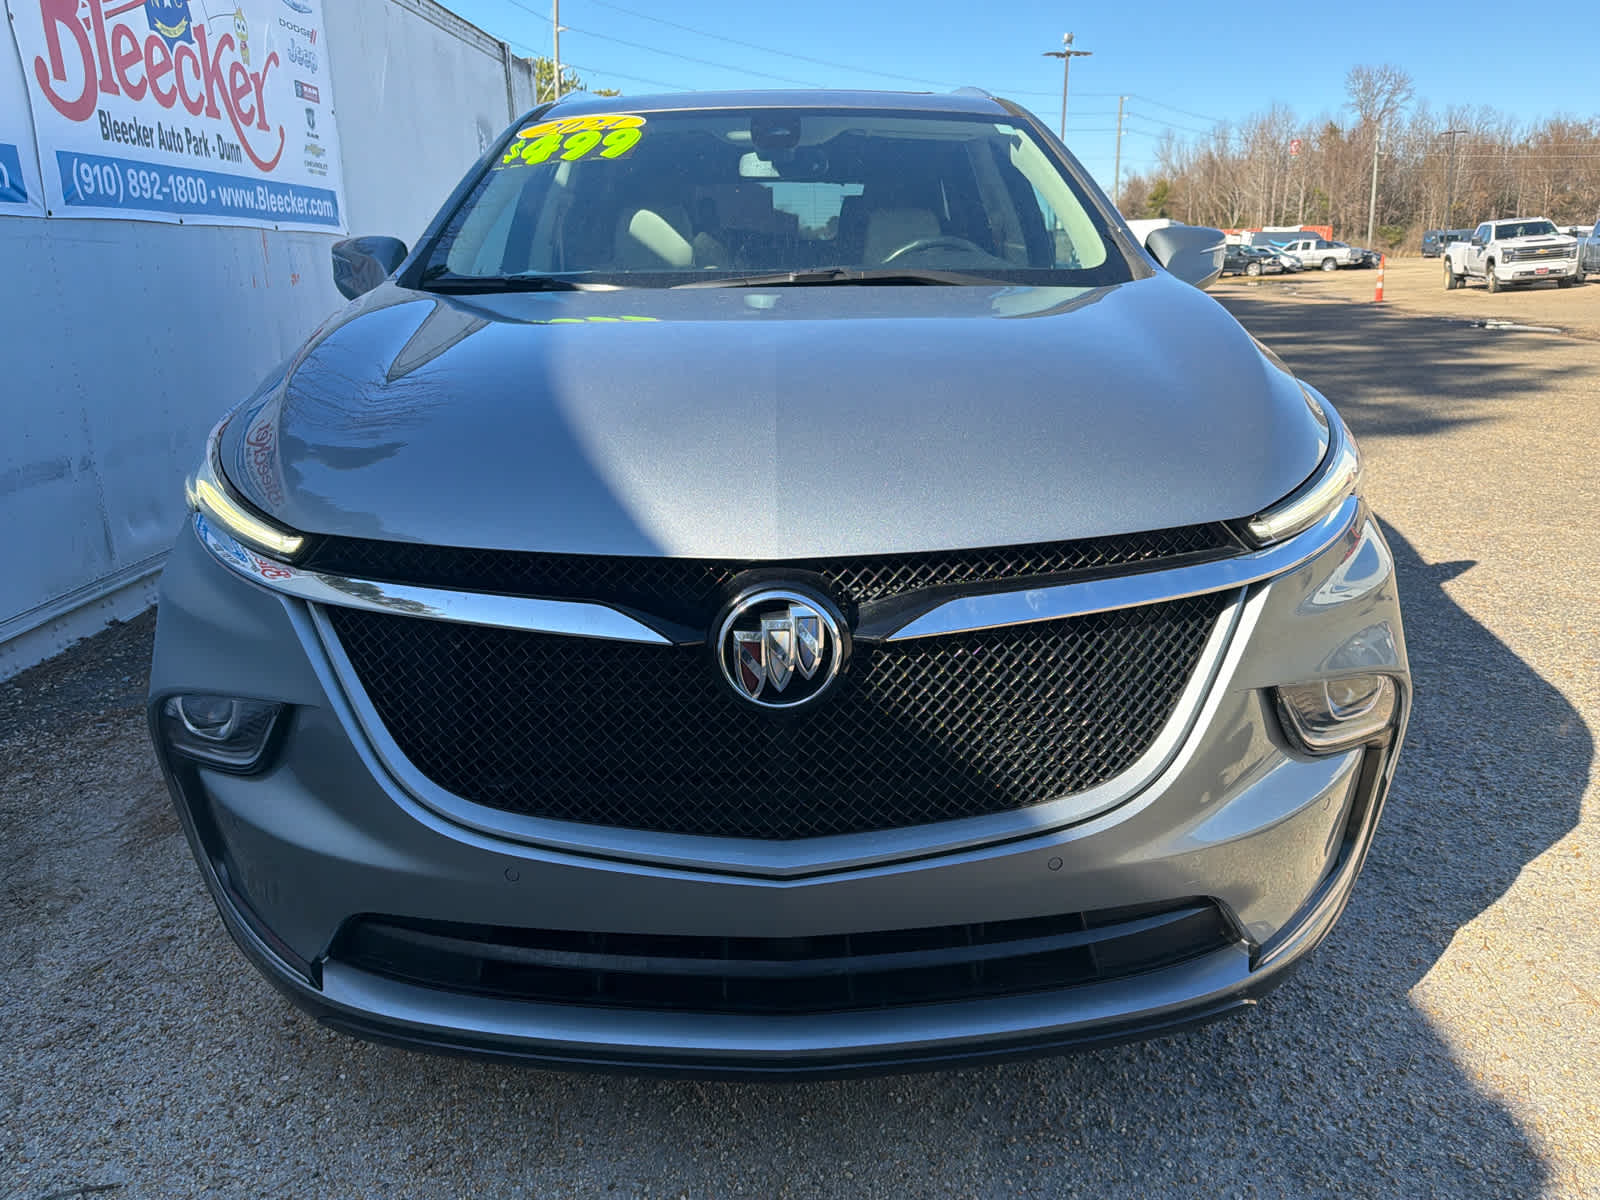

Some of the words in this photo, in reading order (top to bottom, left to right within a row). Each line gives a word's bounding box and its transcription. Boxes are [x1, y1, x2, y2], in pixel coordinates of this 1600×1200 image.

[34, 0, 285, 172] Bleecker
[97, 109, 155, 149] Bleecker
[158, 121, 184, 154] Auto
[184, 127, 211, 160] Park
[216, 134, 243, 164] Dunn
[502, 127, 643, 166] $499
[72, 157, 123, 203] (910)
[128, 173, 208, 206] 892-1800
[218, 182, 335, 218] www.Bleecker.com
